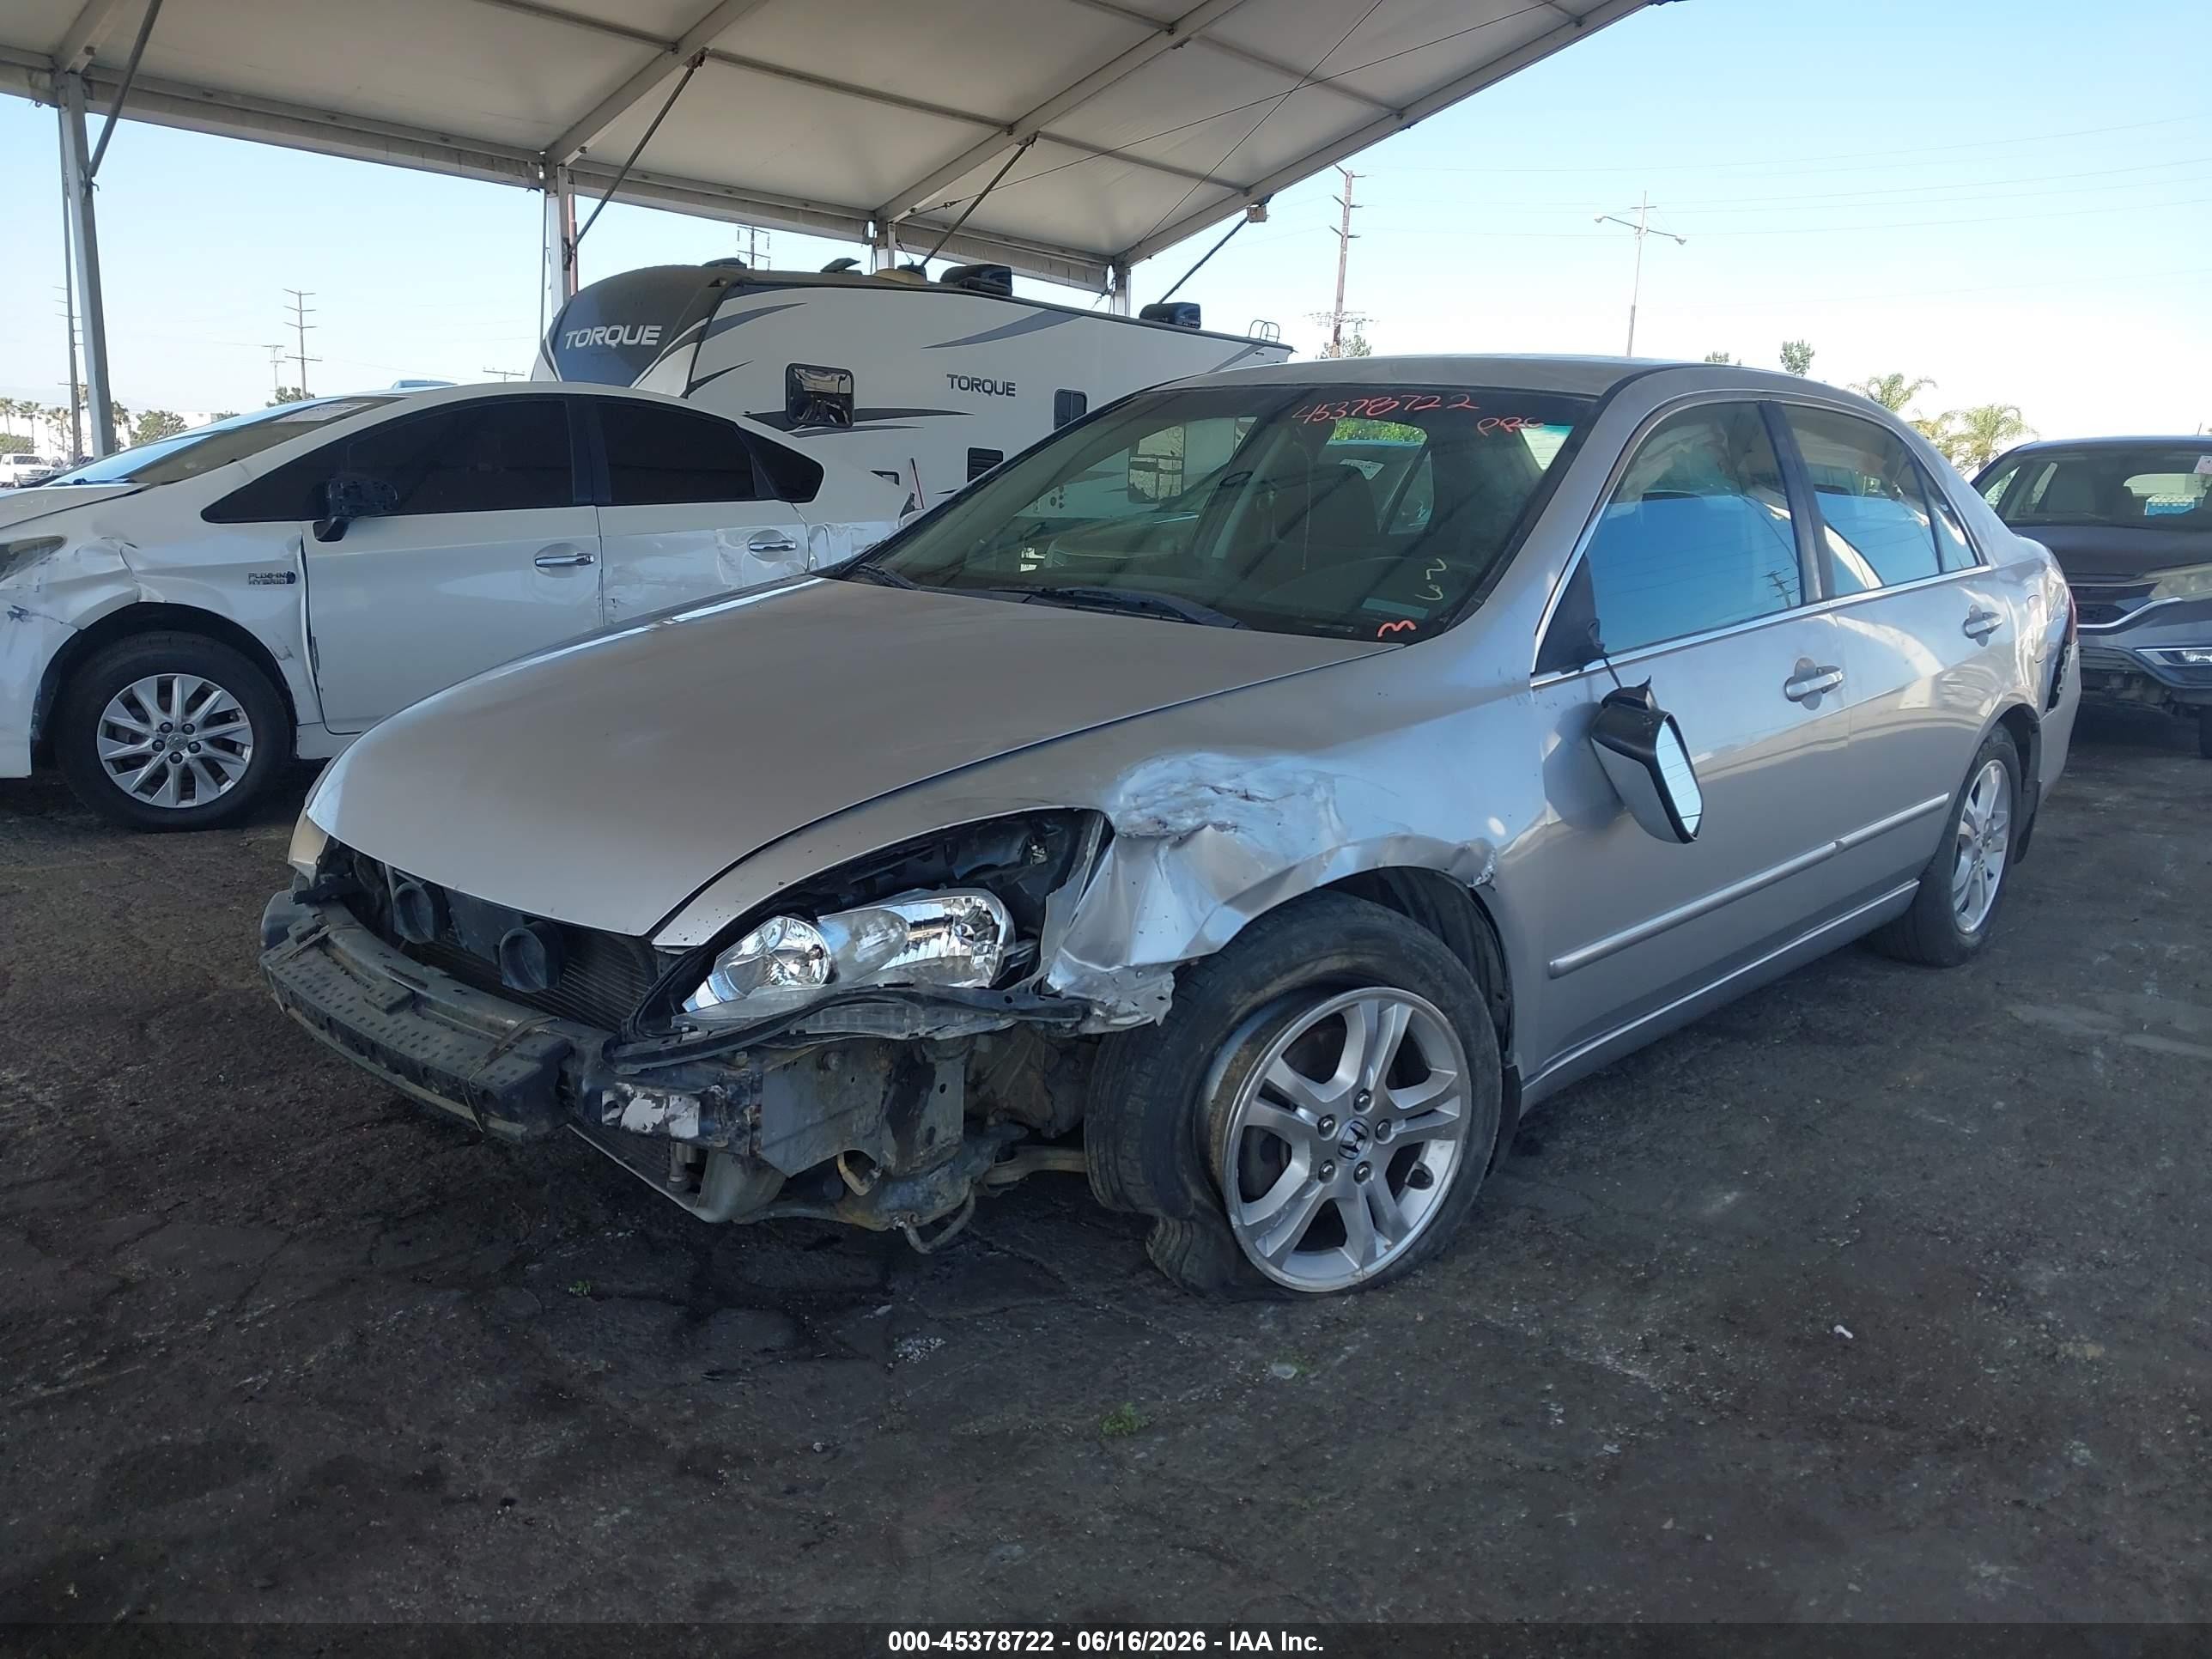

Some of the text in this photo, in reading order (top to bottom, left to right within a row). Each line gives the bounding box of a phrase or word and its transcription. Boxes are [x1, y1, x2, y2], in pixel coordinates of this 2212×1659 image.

[565, 325, 662, 349] TORQUE
[946, 374, 1017, 398] TORQUE
[1291, 393, 1480, 424] 45378722
